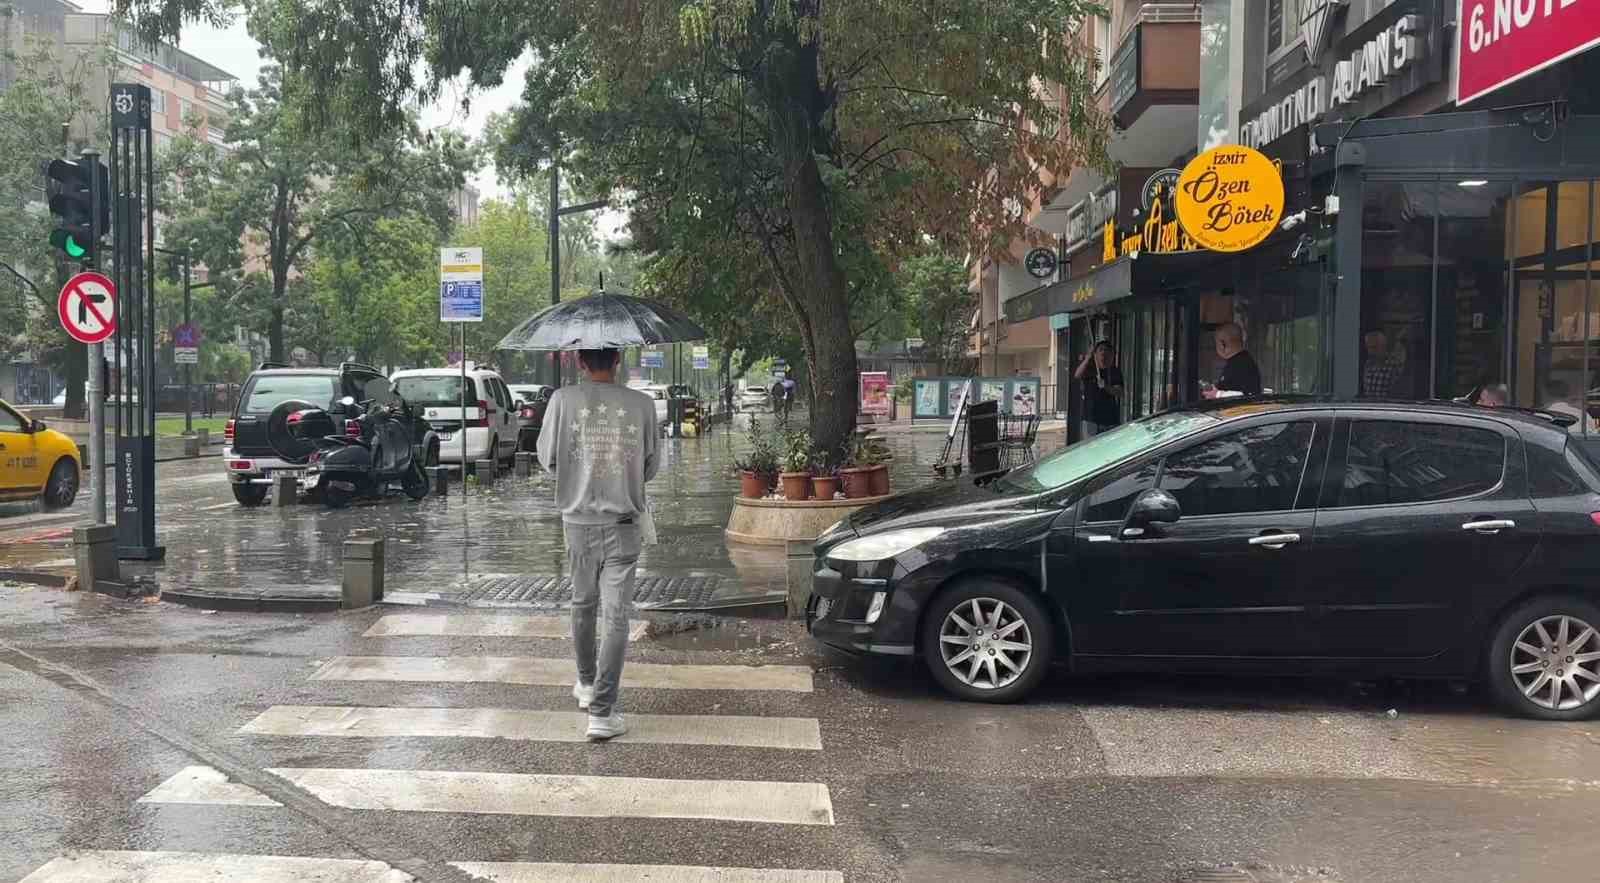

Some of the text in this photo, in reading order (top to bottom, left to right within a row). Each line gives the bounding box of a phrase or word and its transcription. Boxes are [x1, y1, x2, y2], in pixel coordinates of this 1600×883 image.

[1469, 0, 1577, 53] 6.NO
[1330, 16, 1411, 109] AJANS
[1213, 152, 1247, 165] İZMİT
[1184, 167, 1250, 202] Özen
[1203, 201, 1273, 231] Börek
